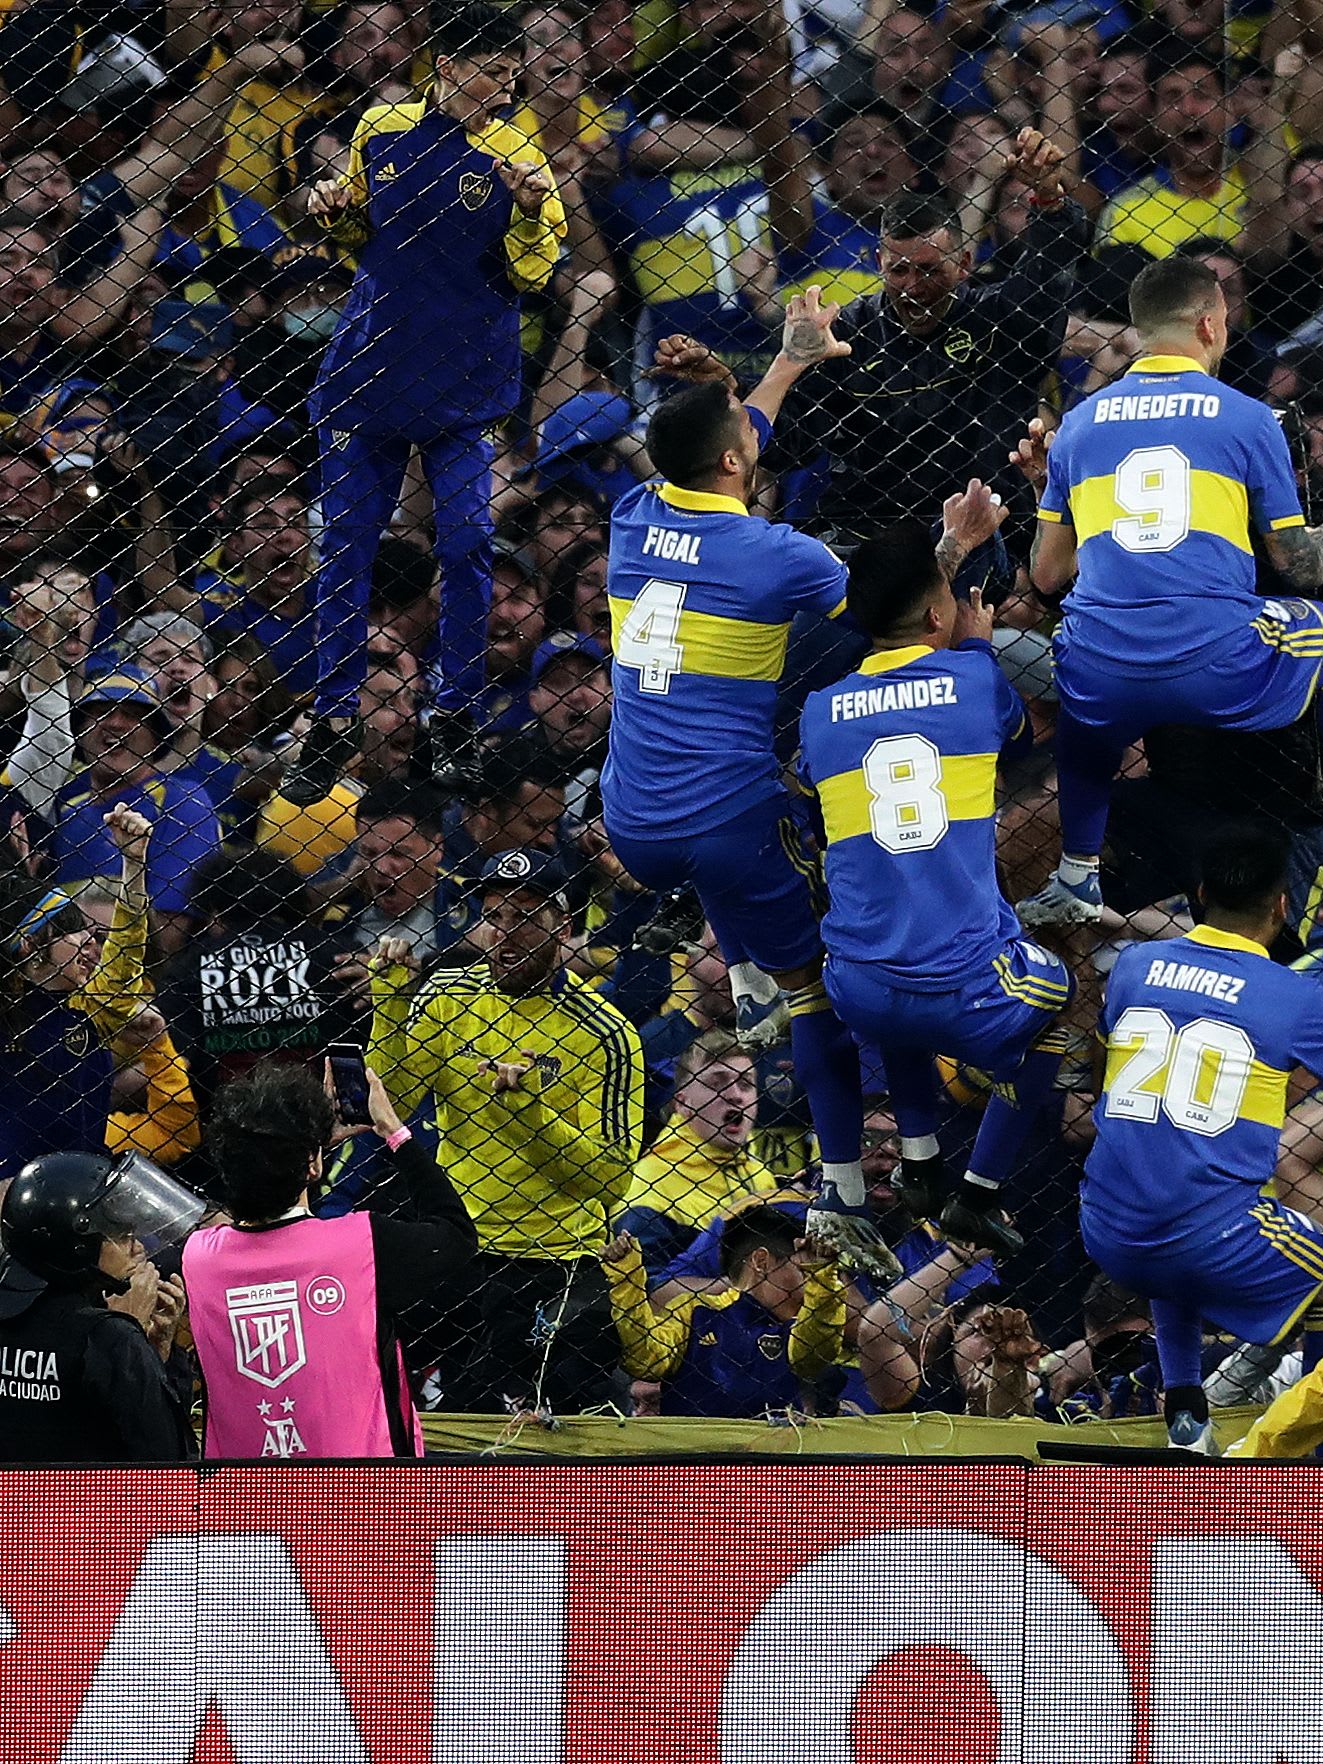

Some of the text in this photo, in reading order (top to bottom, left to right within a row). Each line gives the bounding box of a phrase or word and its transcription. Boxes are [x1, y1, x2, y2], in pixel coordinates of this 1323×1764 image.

[1094, 393, 1220, 424] BENEDETTO
[1111, 445, 1190, 553] 9
[642, 526, 701, 565] FIGAL
[616, 578, 687, 695] 4
[832, 677, 957, 723] FERNANDEZ
[862, 733, 949, 855] 8
[201, 958, 317, 1011] ROCK
[1145, 960, 1246, 1004] RAMIREZ
[1105, 1007, 1255, 1137] 20
[250, 1288, 273, 1300] AFA
[314, 1286, 338, 1305] 09
[0, 1347, 59, 1381] LICIA
[9, 1381, 60, 1401] CIUDAD
[260, 1418, 307, 1458] AFA
